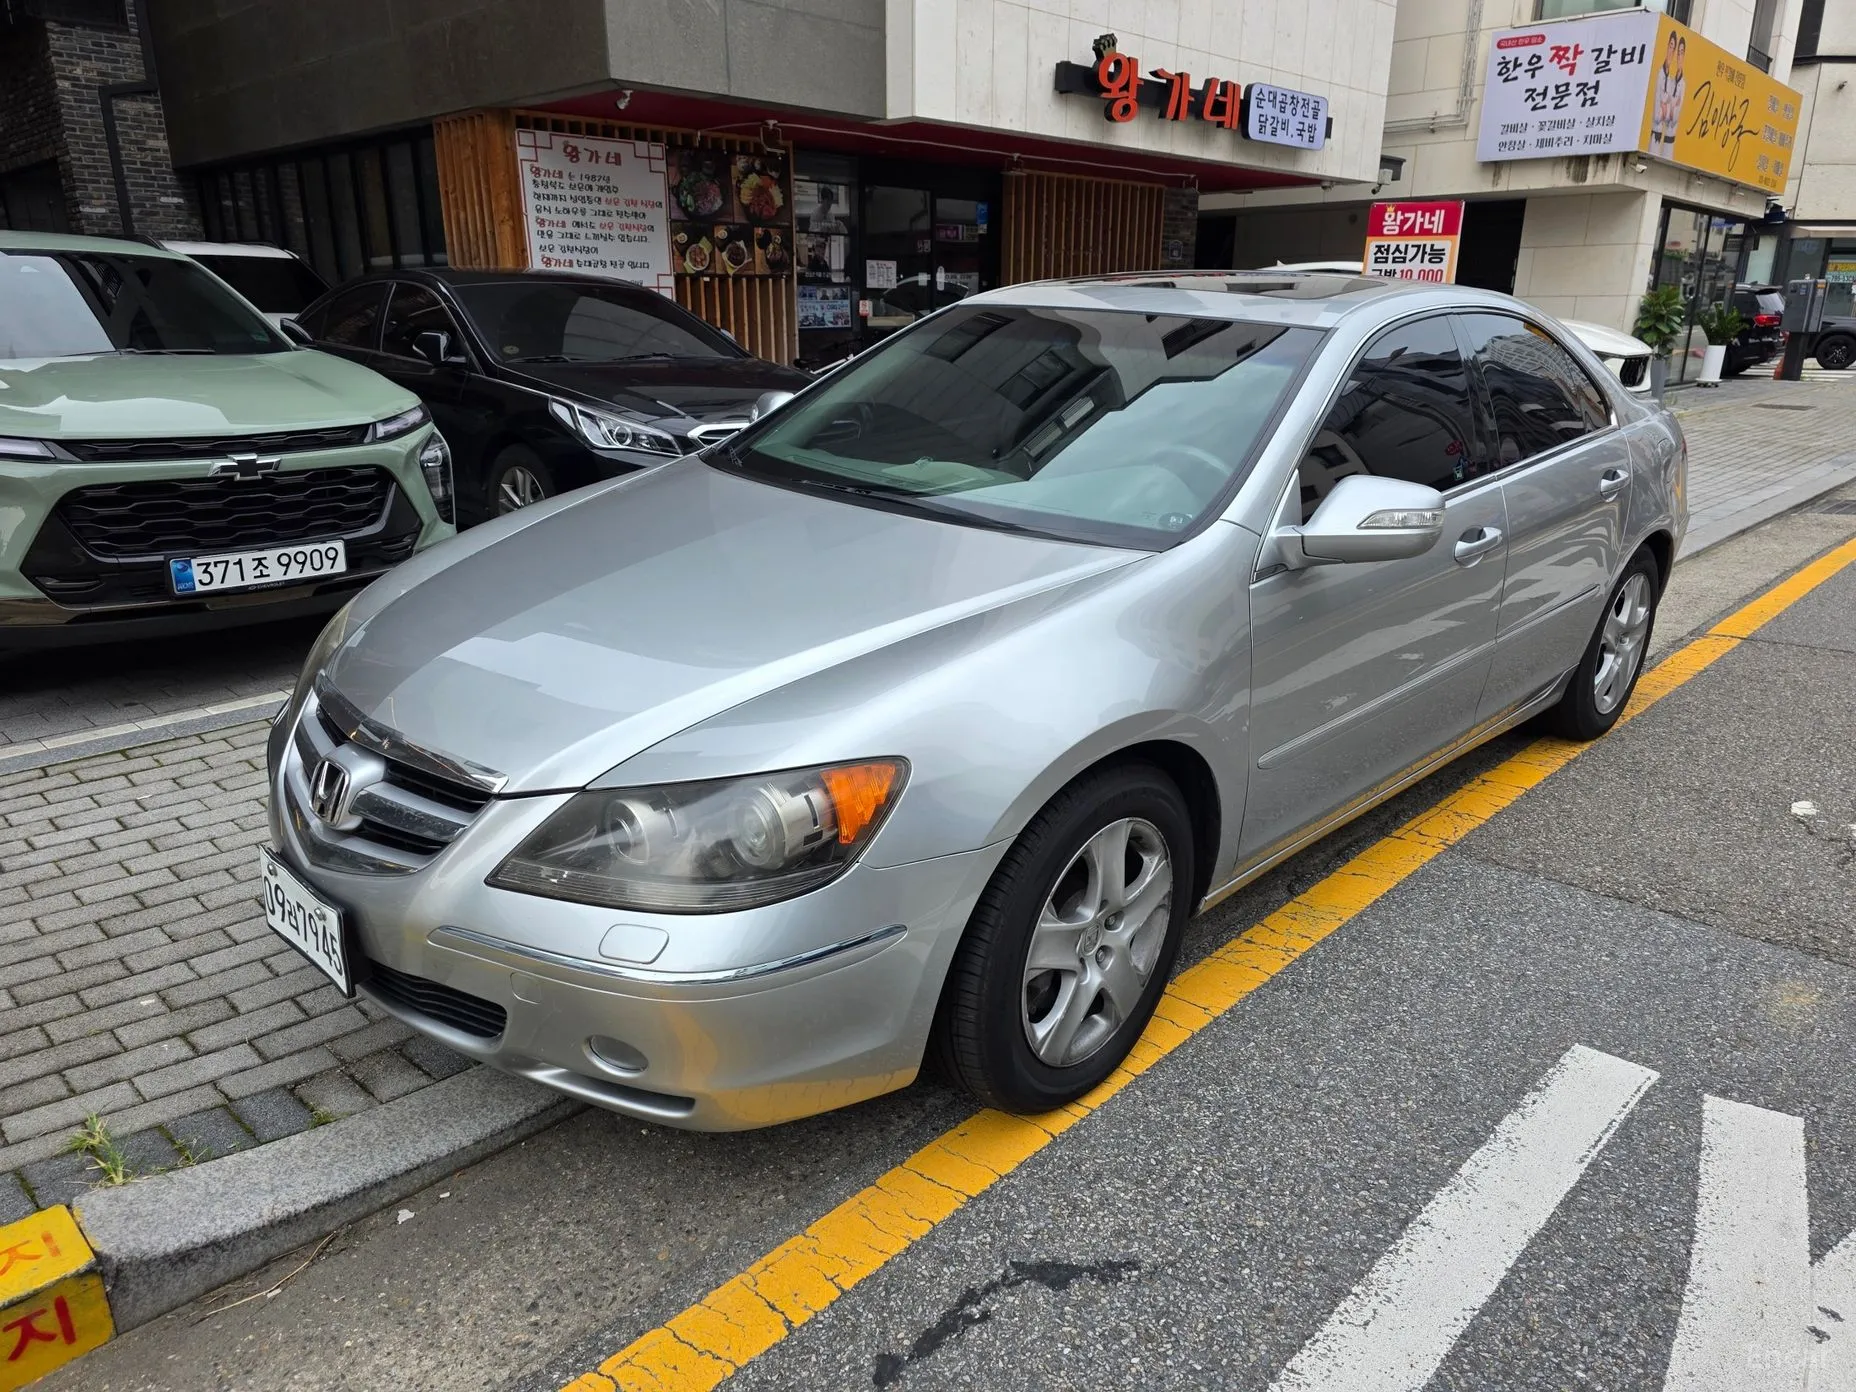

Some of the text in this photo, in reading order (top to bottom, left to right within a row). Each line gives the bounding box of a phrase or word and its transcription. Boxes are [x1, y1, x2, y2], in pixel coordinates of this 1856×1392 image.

[1496, 53, 1544, 83] 한우
[1098, 52, 1241, 130] 왕가네
[1255, 88, 1321, 121] 순대곱창전골
[1524, 80, 1601, 112] 전문점
[1500, 115, 1616, 135] 갈비살 꽃갈비살 살치살
[563, 144, 622, 166] 왕가네
[1498, 133, 1613, 152] 안창살 제비추리 치마살
[1382, 208, 1445, 235] 왕가네
[1373, 243, 1446, 264] 점심가능
[3, 1296, 77, 1362] 지
